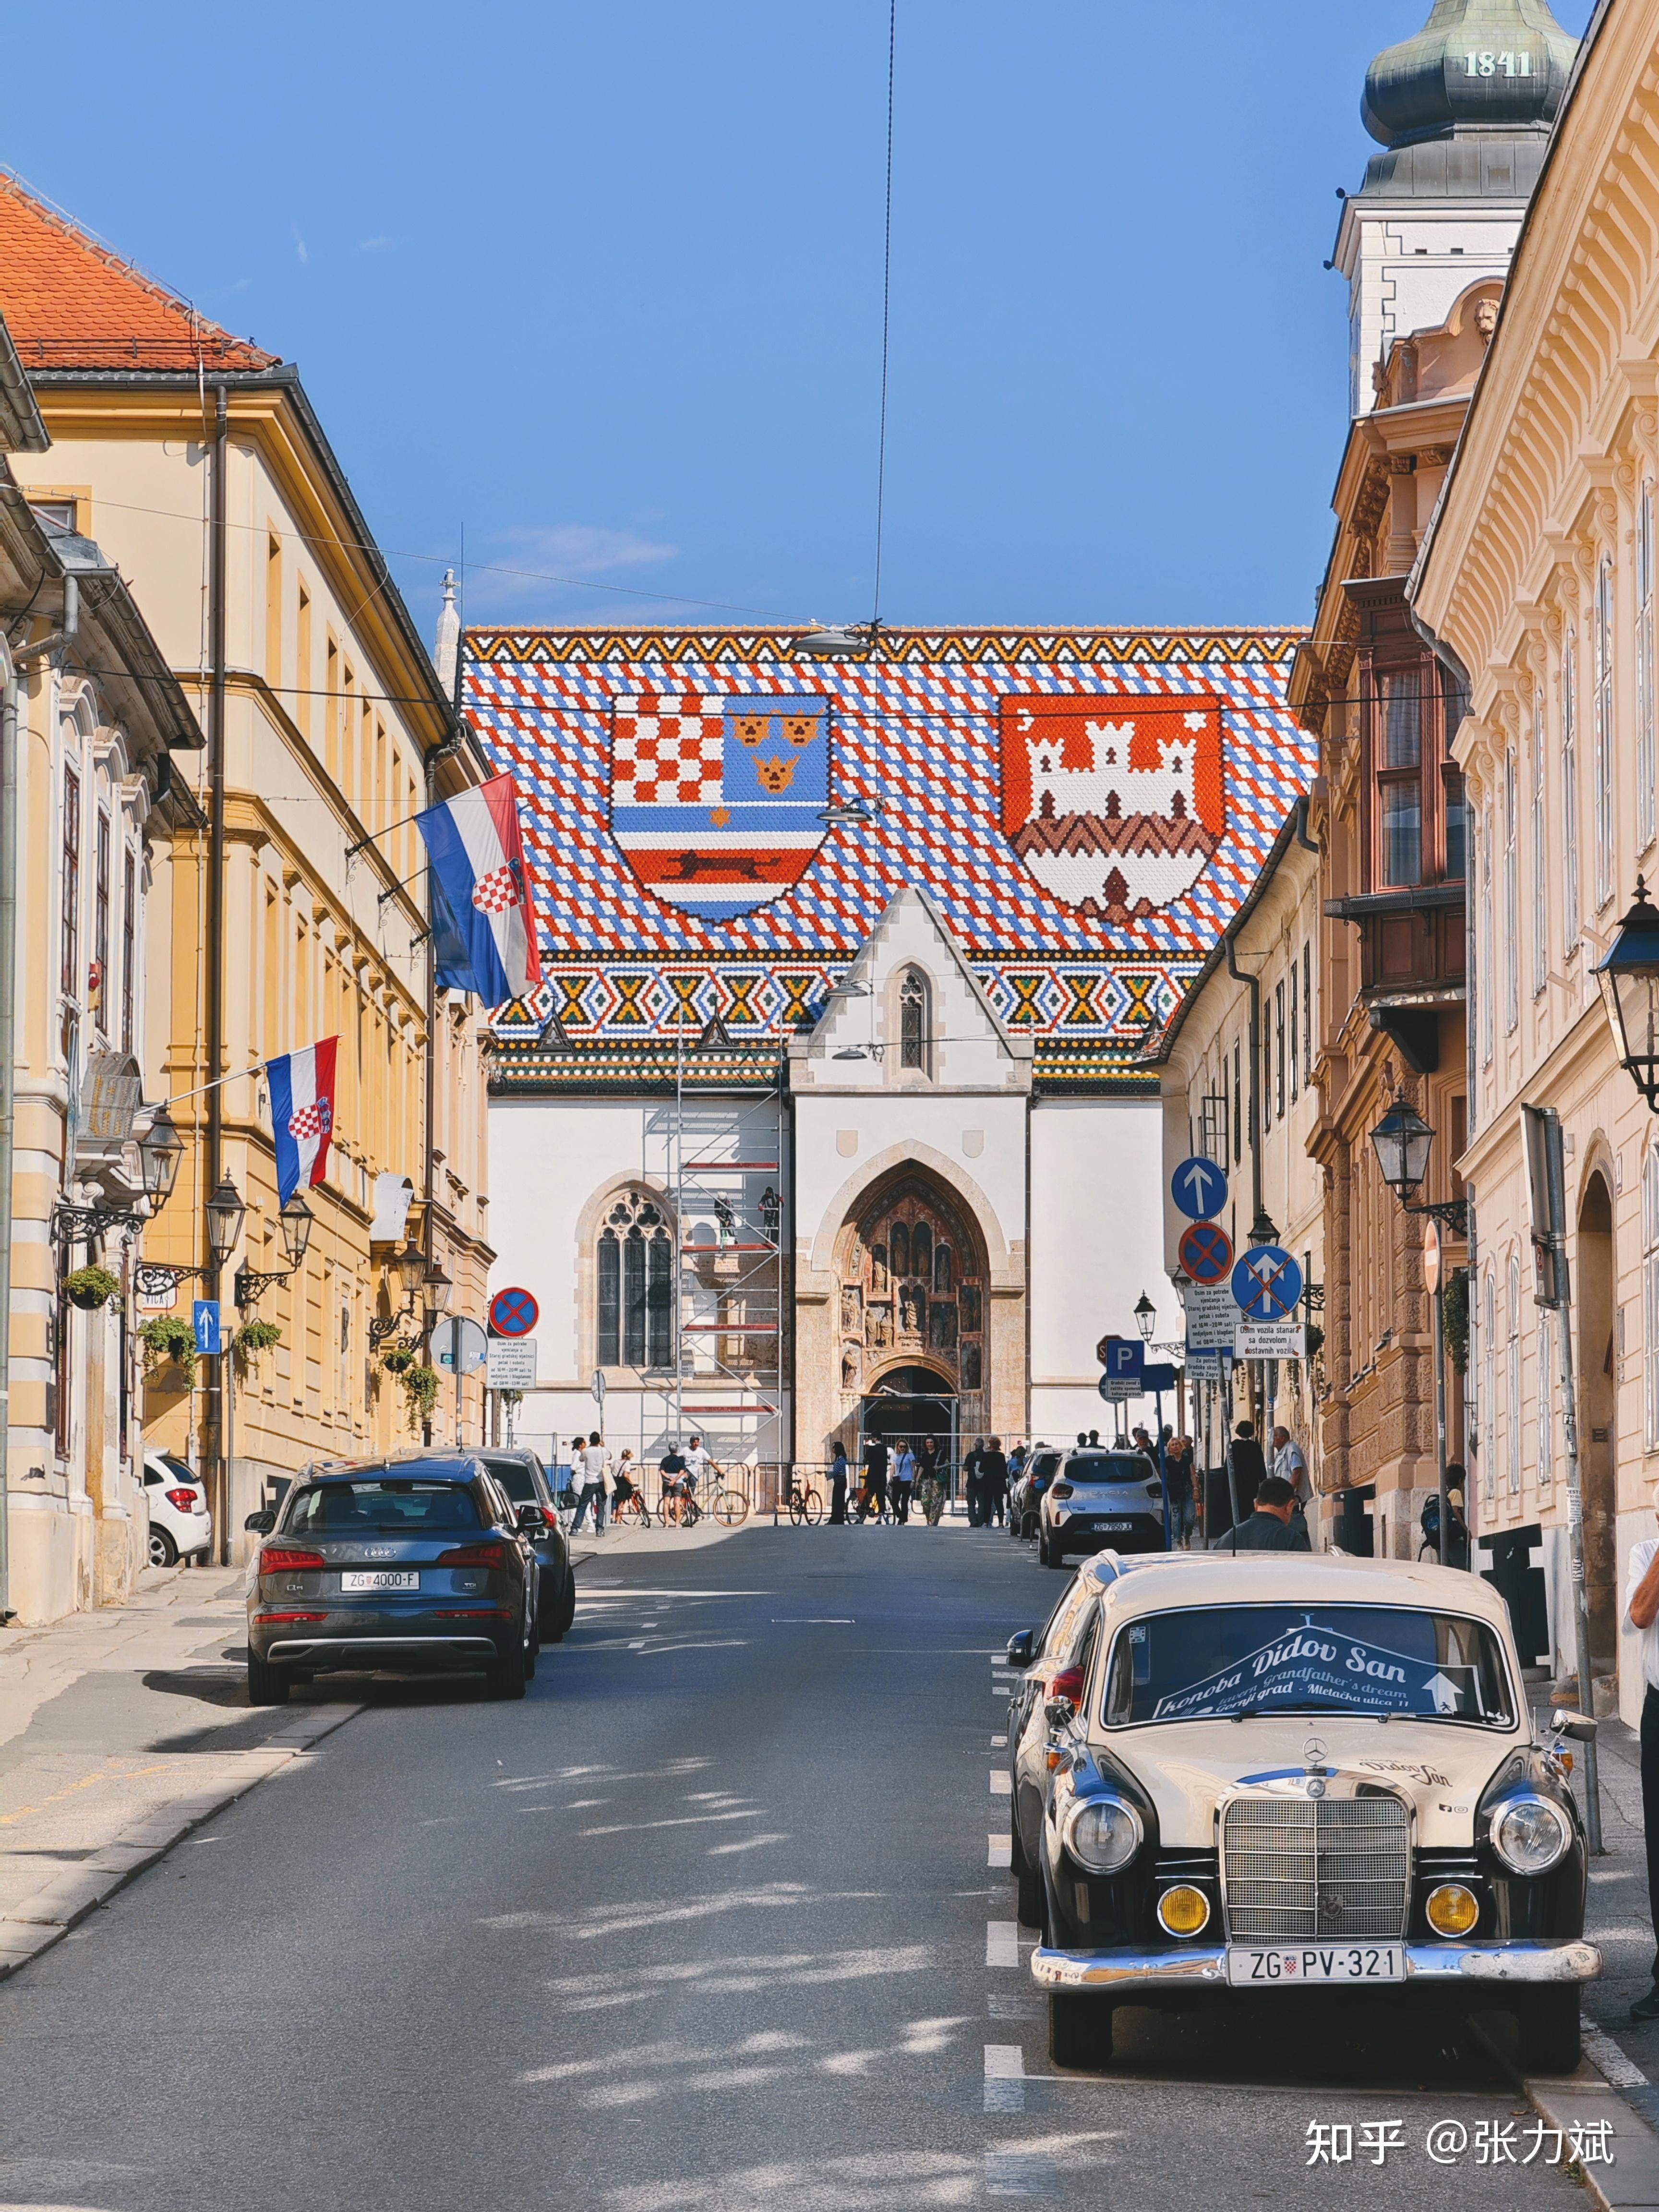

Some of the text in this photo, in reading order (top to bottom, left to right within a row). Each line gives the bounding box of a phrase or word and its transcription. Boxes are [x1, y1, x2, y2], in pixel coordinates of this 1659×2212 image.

[1118, 1347, 1132, 1370] P
[350, 1574, 414, 1586] ZG 4000-F
[1162, 1635, 1406, 1715] konoba Didov San
[1216, 1692, 1257, 1712] Gornji
[1257, 1682, 1293, 1701] grad
[1307, 1683, 1360, 1702] Mletačka
[1219, 1685, 1257, 1705] tavern
[1361, 1684, 1407, 1698] dream
[1359, 1762, 1453, 1787] Didov San
[1250, 1950, 1393, 1979] ZG PV-321
